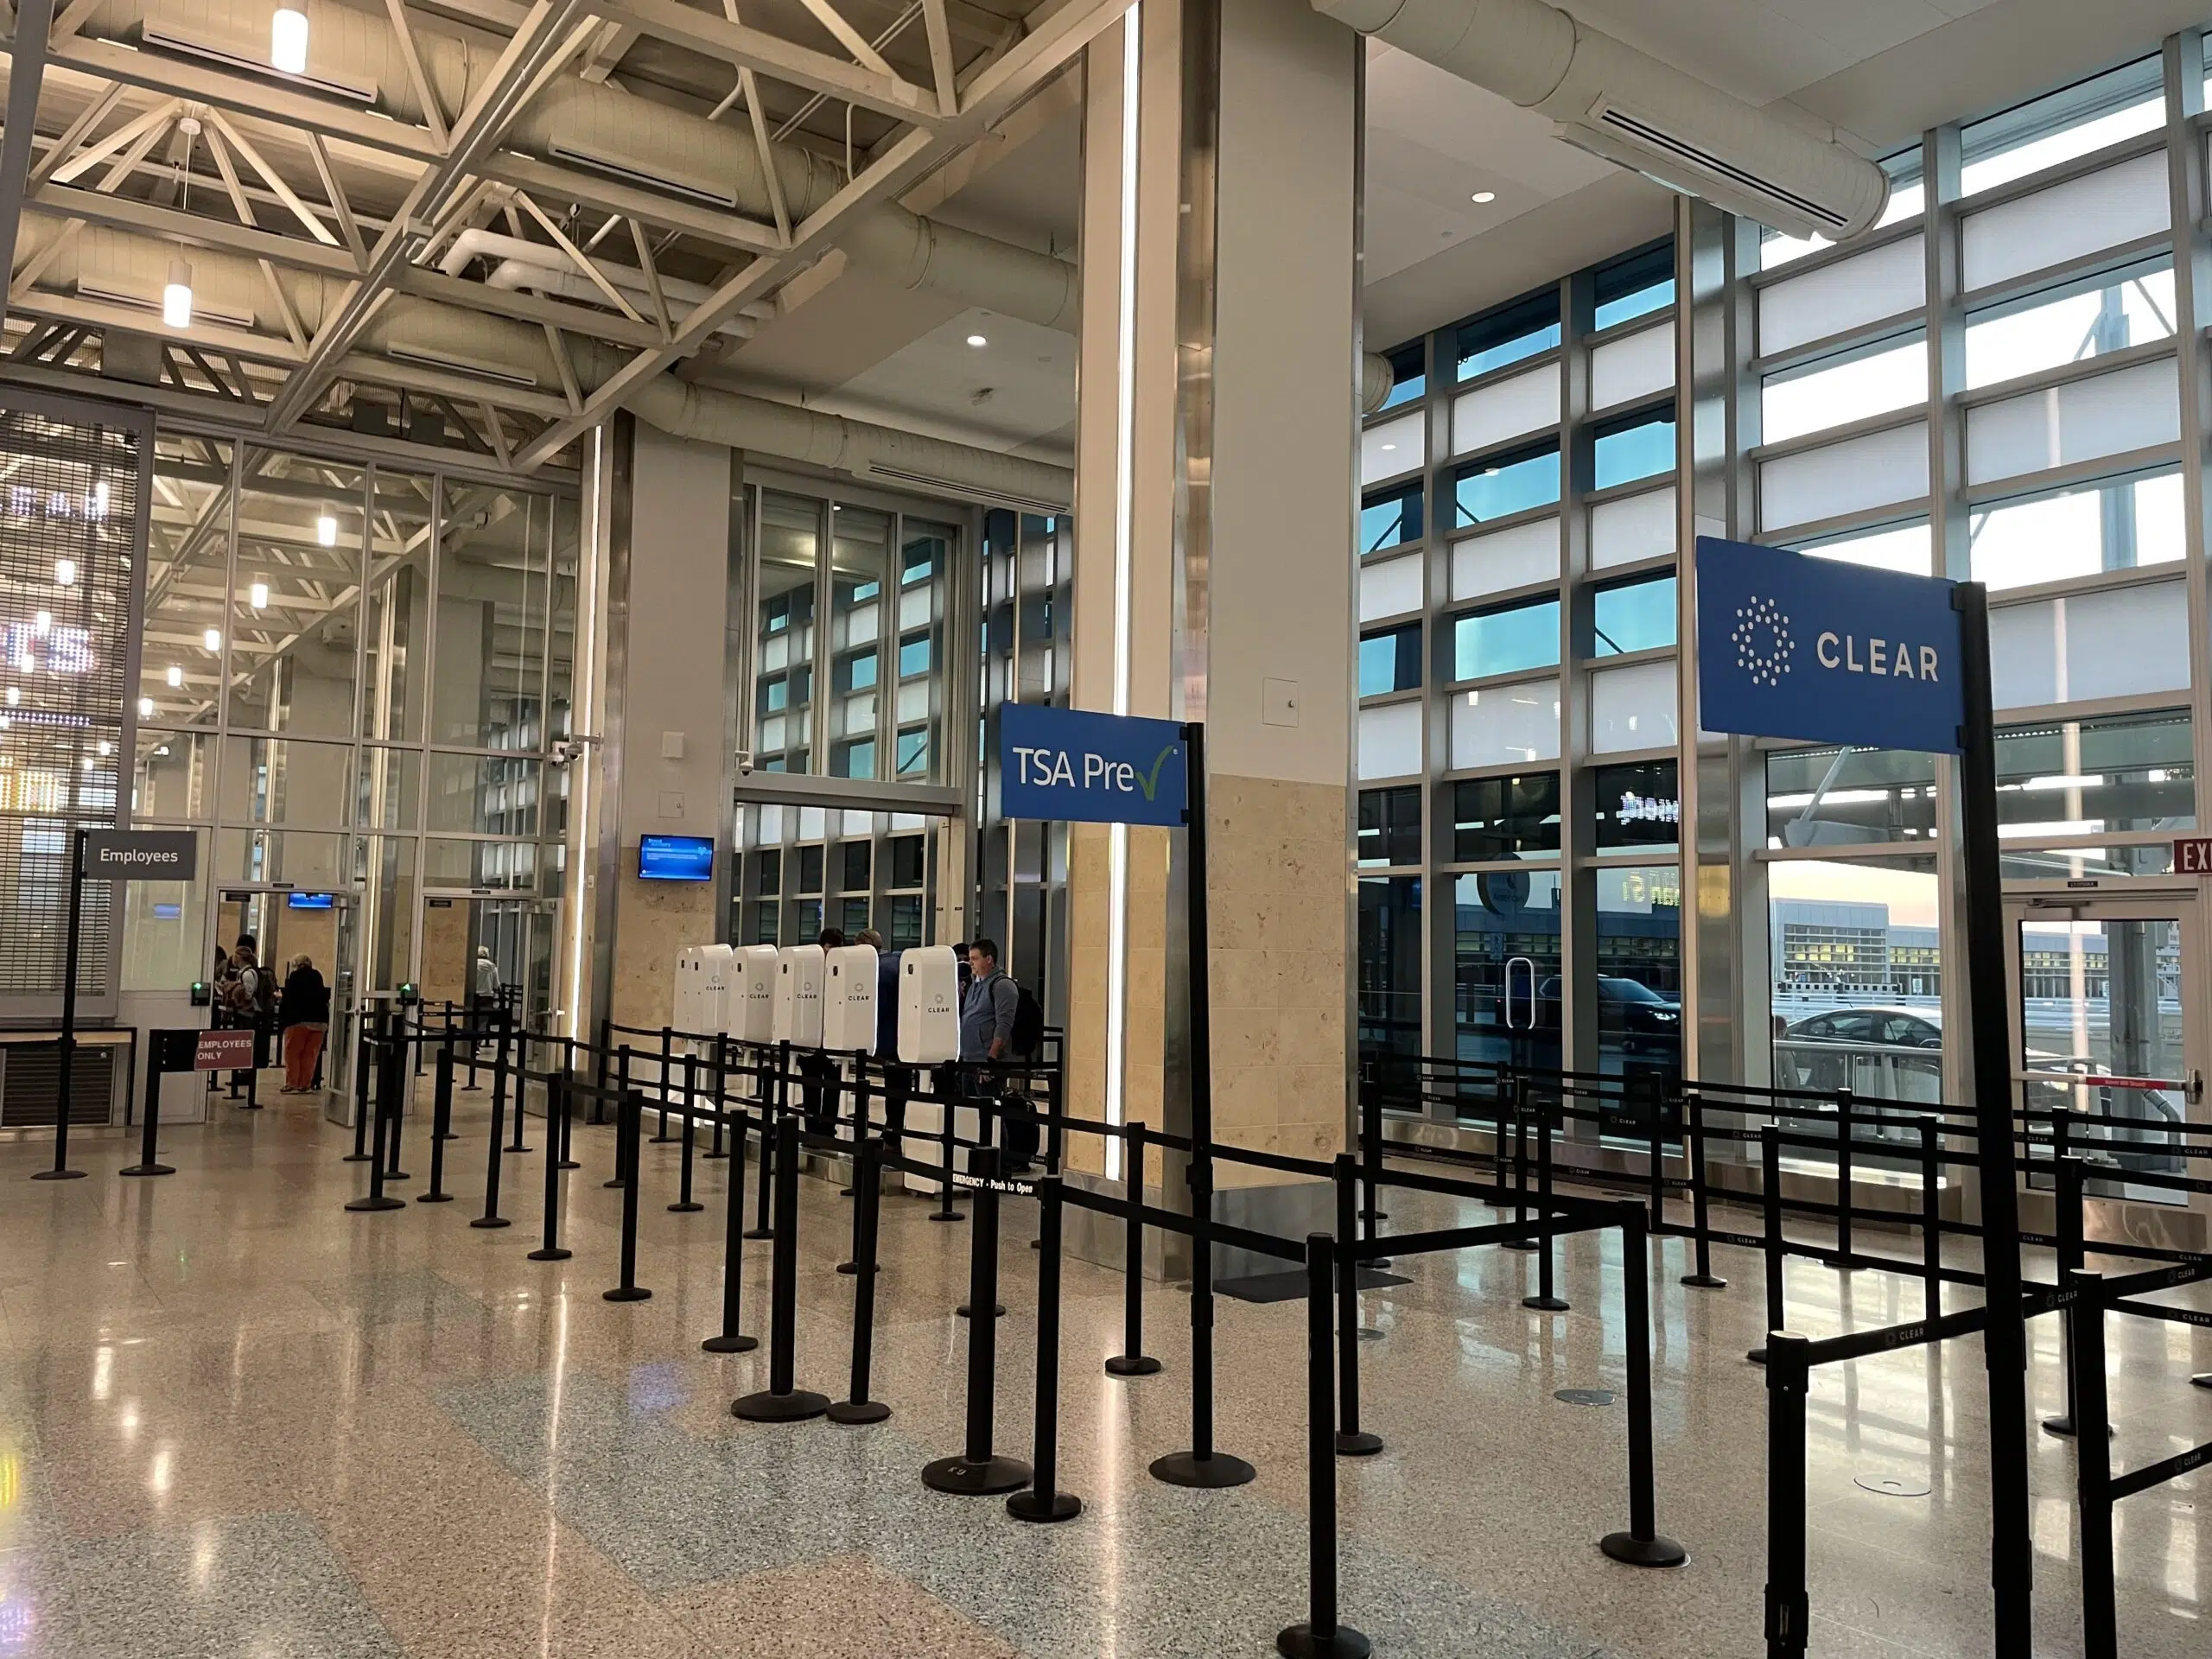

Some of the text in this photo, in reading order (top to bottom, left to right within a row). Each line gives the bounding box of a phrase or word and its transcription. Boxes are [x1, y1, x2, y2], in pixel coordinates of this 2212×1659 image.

[1817, 632, 1938, 682] CLEAR
[1012, 747, 1076, 787] TSA
[100, 848, 179, 865] Employees
[198, 1039, 252, 1049] EMPLOYEES
[197, 1052, 222, 1060] ONLY
[952, 1173, 985, 1188] EMERGENCY
[990, 1179, 1006, 1191] Push
[1007, 1181, 1014, 1192] to
[1016, 1182, 1033, 1194] Open
[2183, 1313, 2210, 1323] CLEAR
[1899, 1327, 1925, 1341] CLEAR
